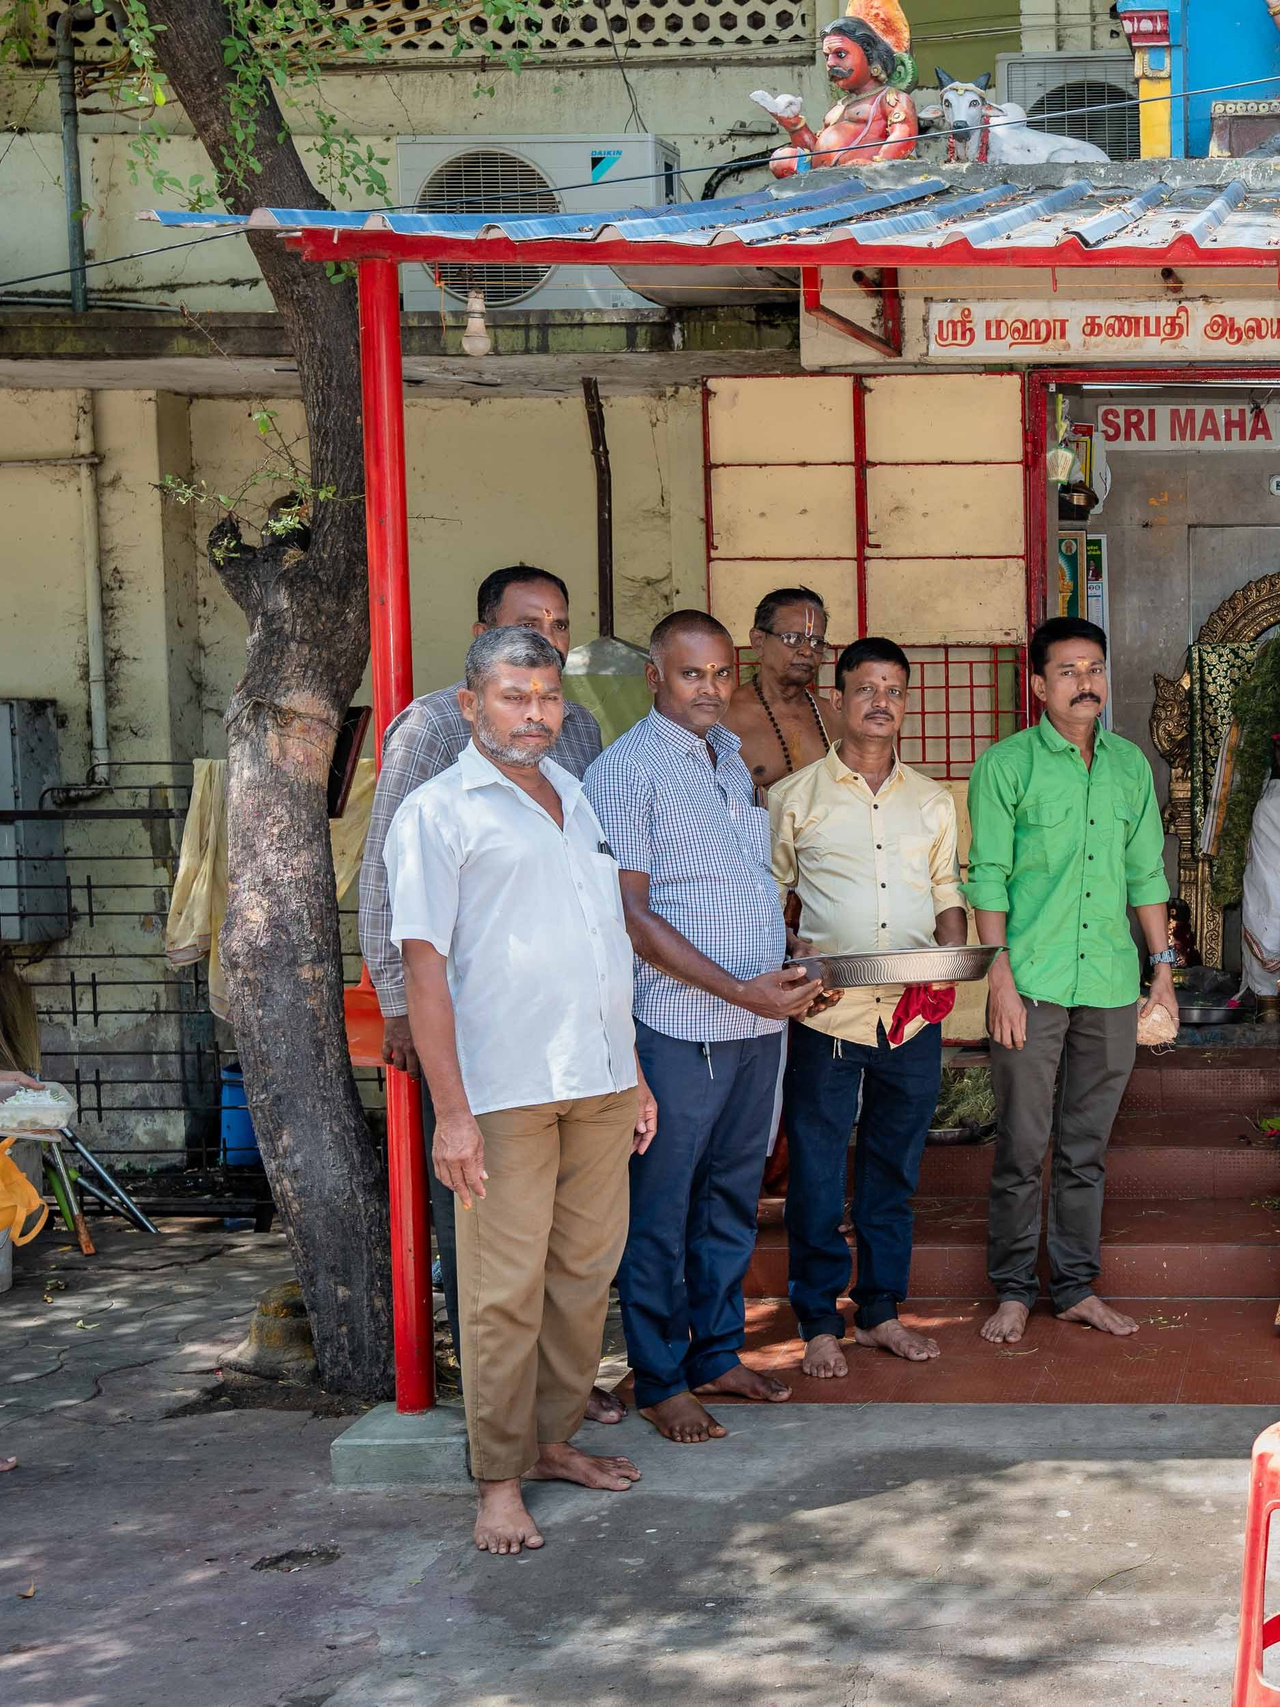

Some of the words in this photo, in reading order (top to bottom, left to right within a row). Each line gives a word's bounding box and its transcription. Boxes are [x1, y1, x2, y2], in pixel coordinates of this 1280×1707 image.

[934, 307, 976, 347] ஸ்ரீ
[984, 316, 1069, 350] மஹா
[1082, 305, 1190, 343] கணபதி
[1100, 408, 1156, 442] SRI
[1168, 407, 1273, 442] MAHA
